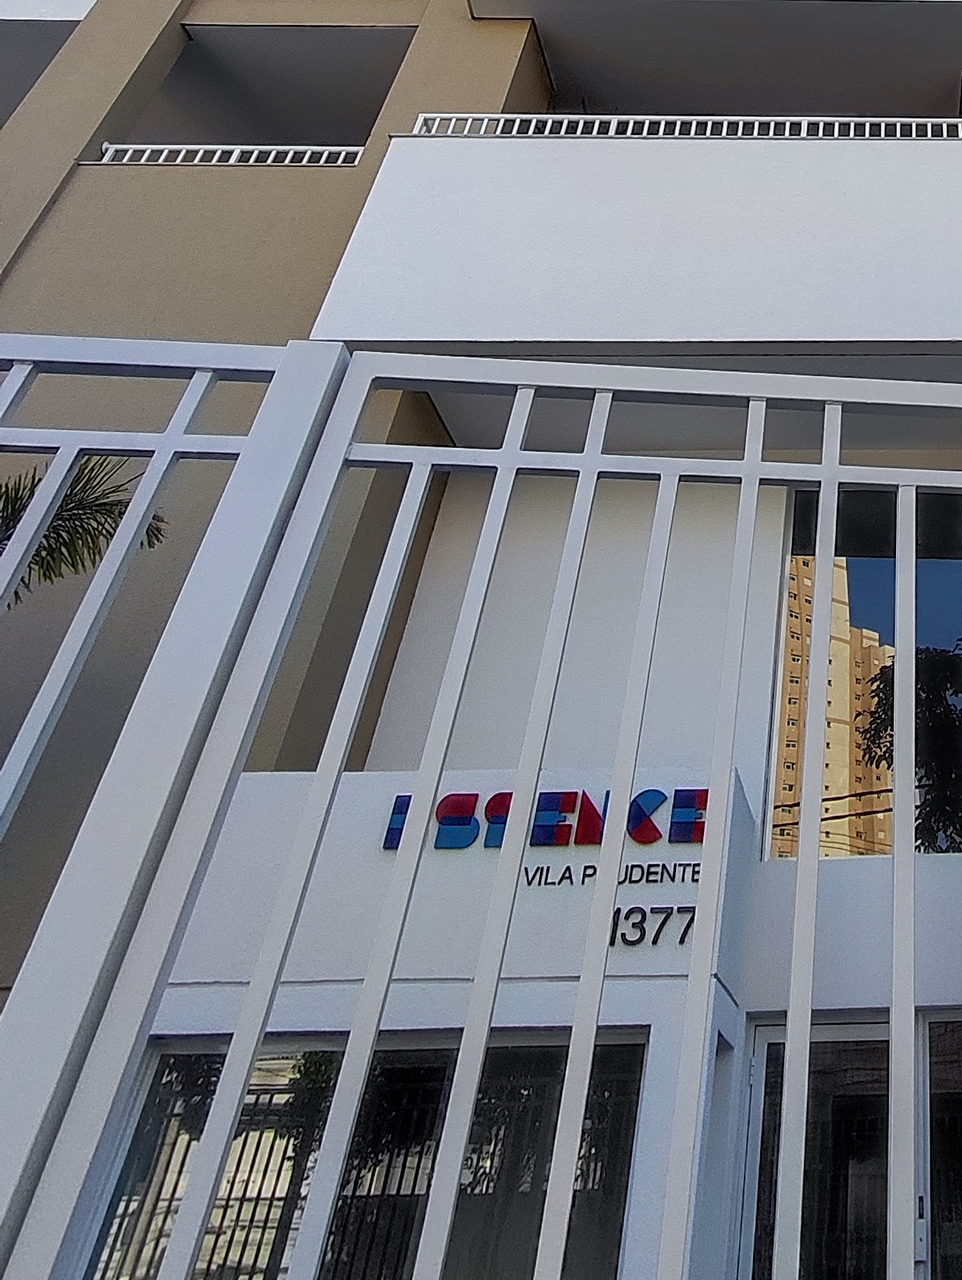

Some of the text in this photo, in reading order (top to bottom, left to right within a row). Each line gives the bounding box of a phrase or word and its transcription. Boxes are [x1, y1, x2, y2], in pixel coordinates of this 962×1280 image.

[524, 863, 701, 886] VILA PUDENTE
[609, 906, 696, 946] 1377
